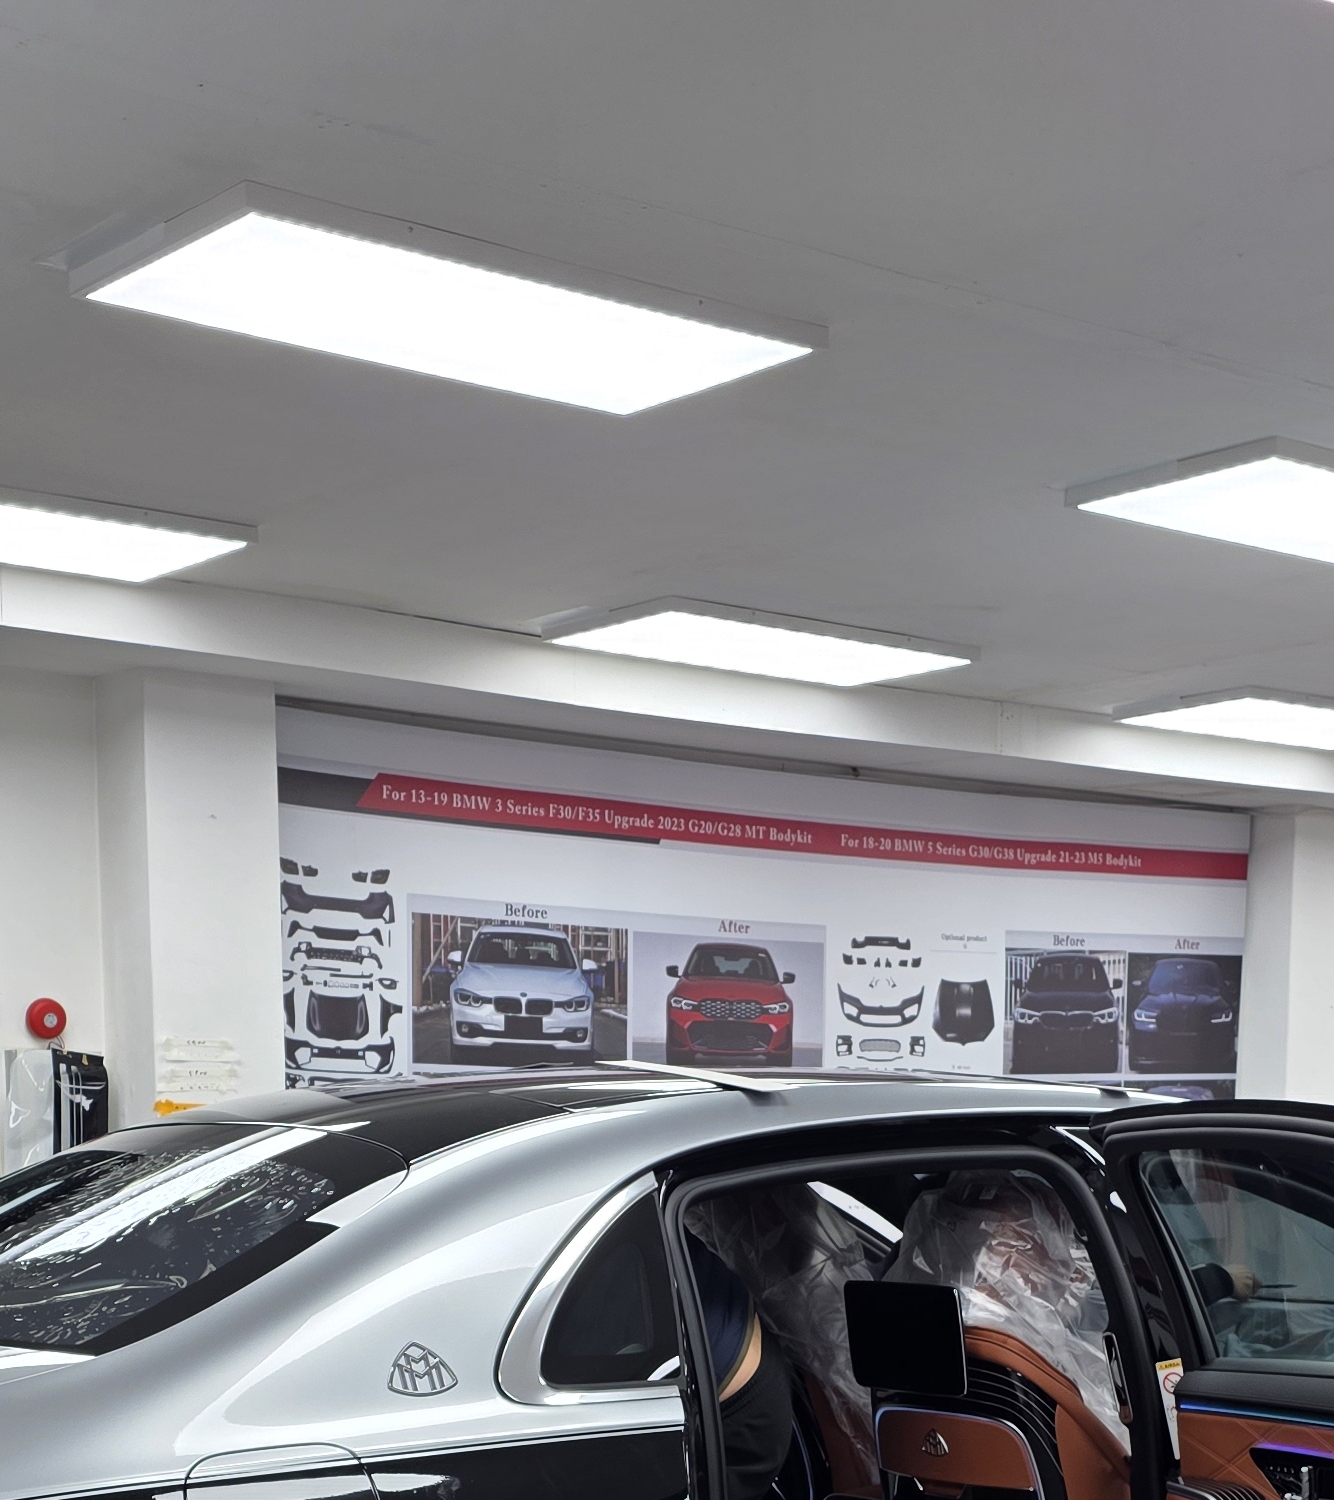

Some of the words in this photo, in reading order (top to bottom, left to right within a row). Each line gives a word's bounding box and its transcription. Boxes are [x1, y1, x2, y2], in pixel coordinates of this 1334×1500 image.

[382, 784, 406, 802] For
[410, 789, 448, 806] 13-19
[452, 793, 492, 812] BMW
[495, 799, 503, 813] 3
[506, 800, 545, 817] Series
[549, 803, 601, 823] F30/F35
[604, 809, 655, 830] Upgrade
[657, 816, 685, 832] 2023
[688, 818, 742, 838] G20/G28
[744, 824, 767, 840] MT
[769, 827, 812, 847] Bodykit
[840, 833, 859, 849] For
[862, 835, 892, 851] 18-20
[894, 838, 926, 853] BMW
[927, 840, 934, 854] 5
[936, 841, 967, 857] Series
[1017, 848, 1057, 866] Upgrade
[1059, 851, 1086, 865] 21-23
[1087, 852, 1103, 866] M5
[1105, 853, 1142, 870] Bodykit
[504, 903, 548, 920] Before
[717, 919, 751, 935] After
[1053, 934, 1086, 948] Before
[1175, 938, 1201, 950] After
